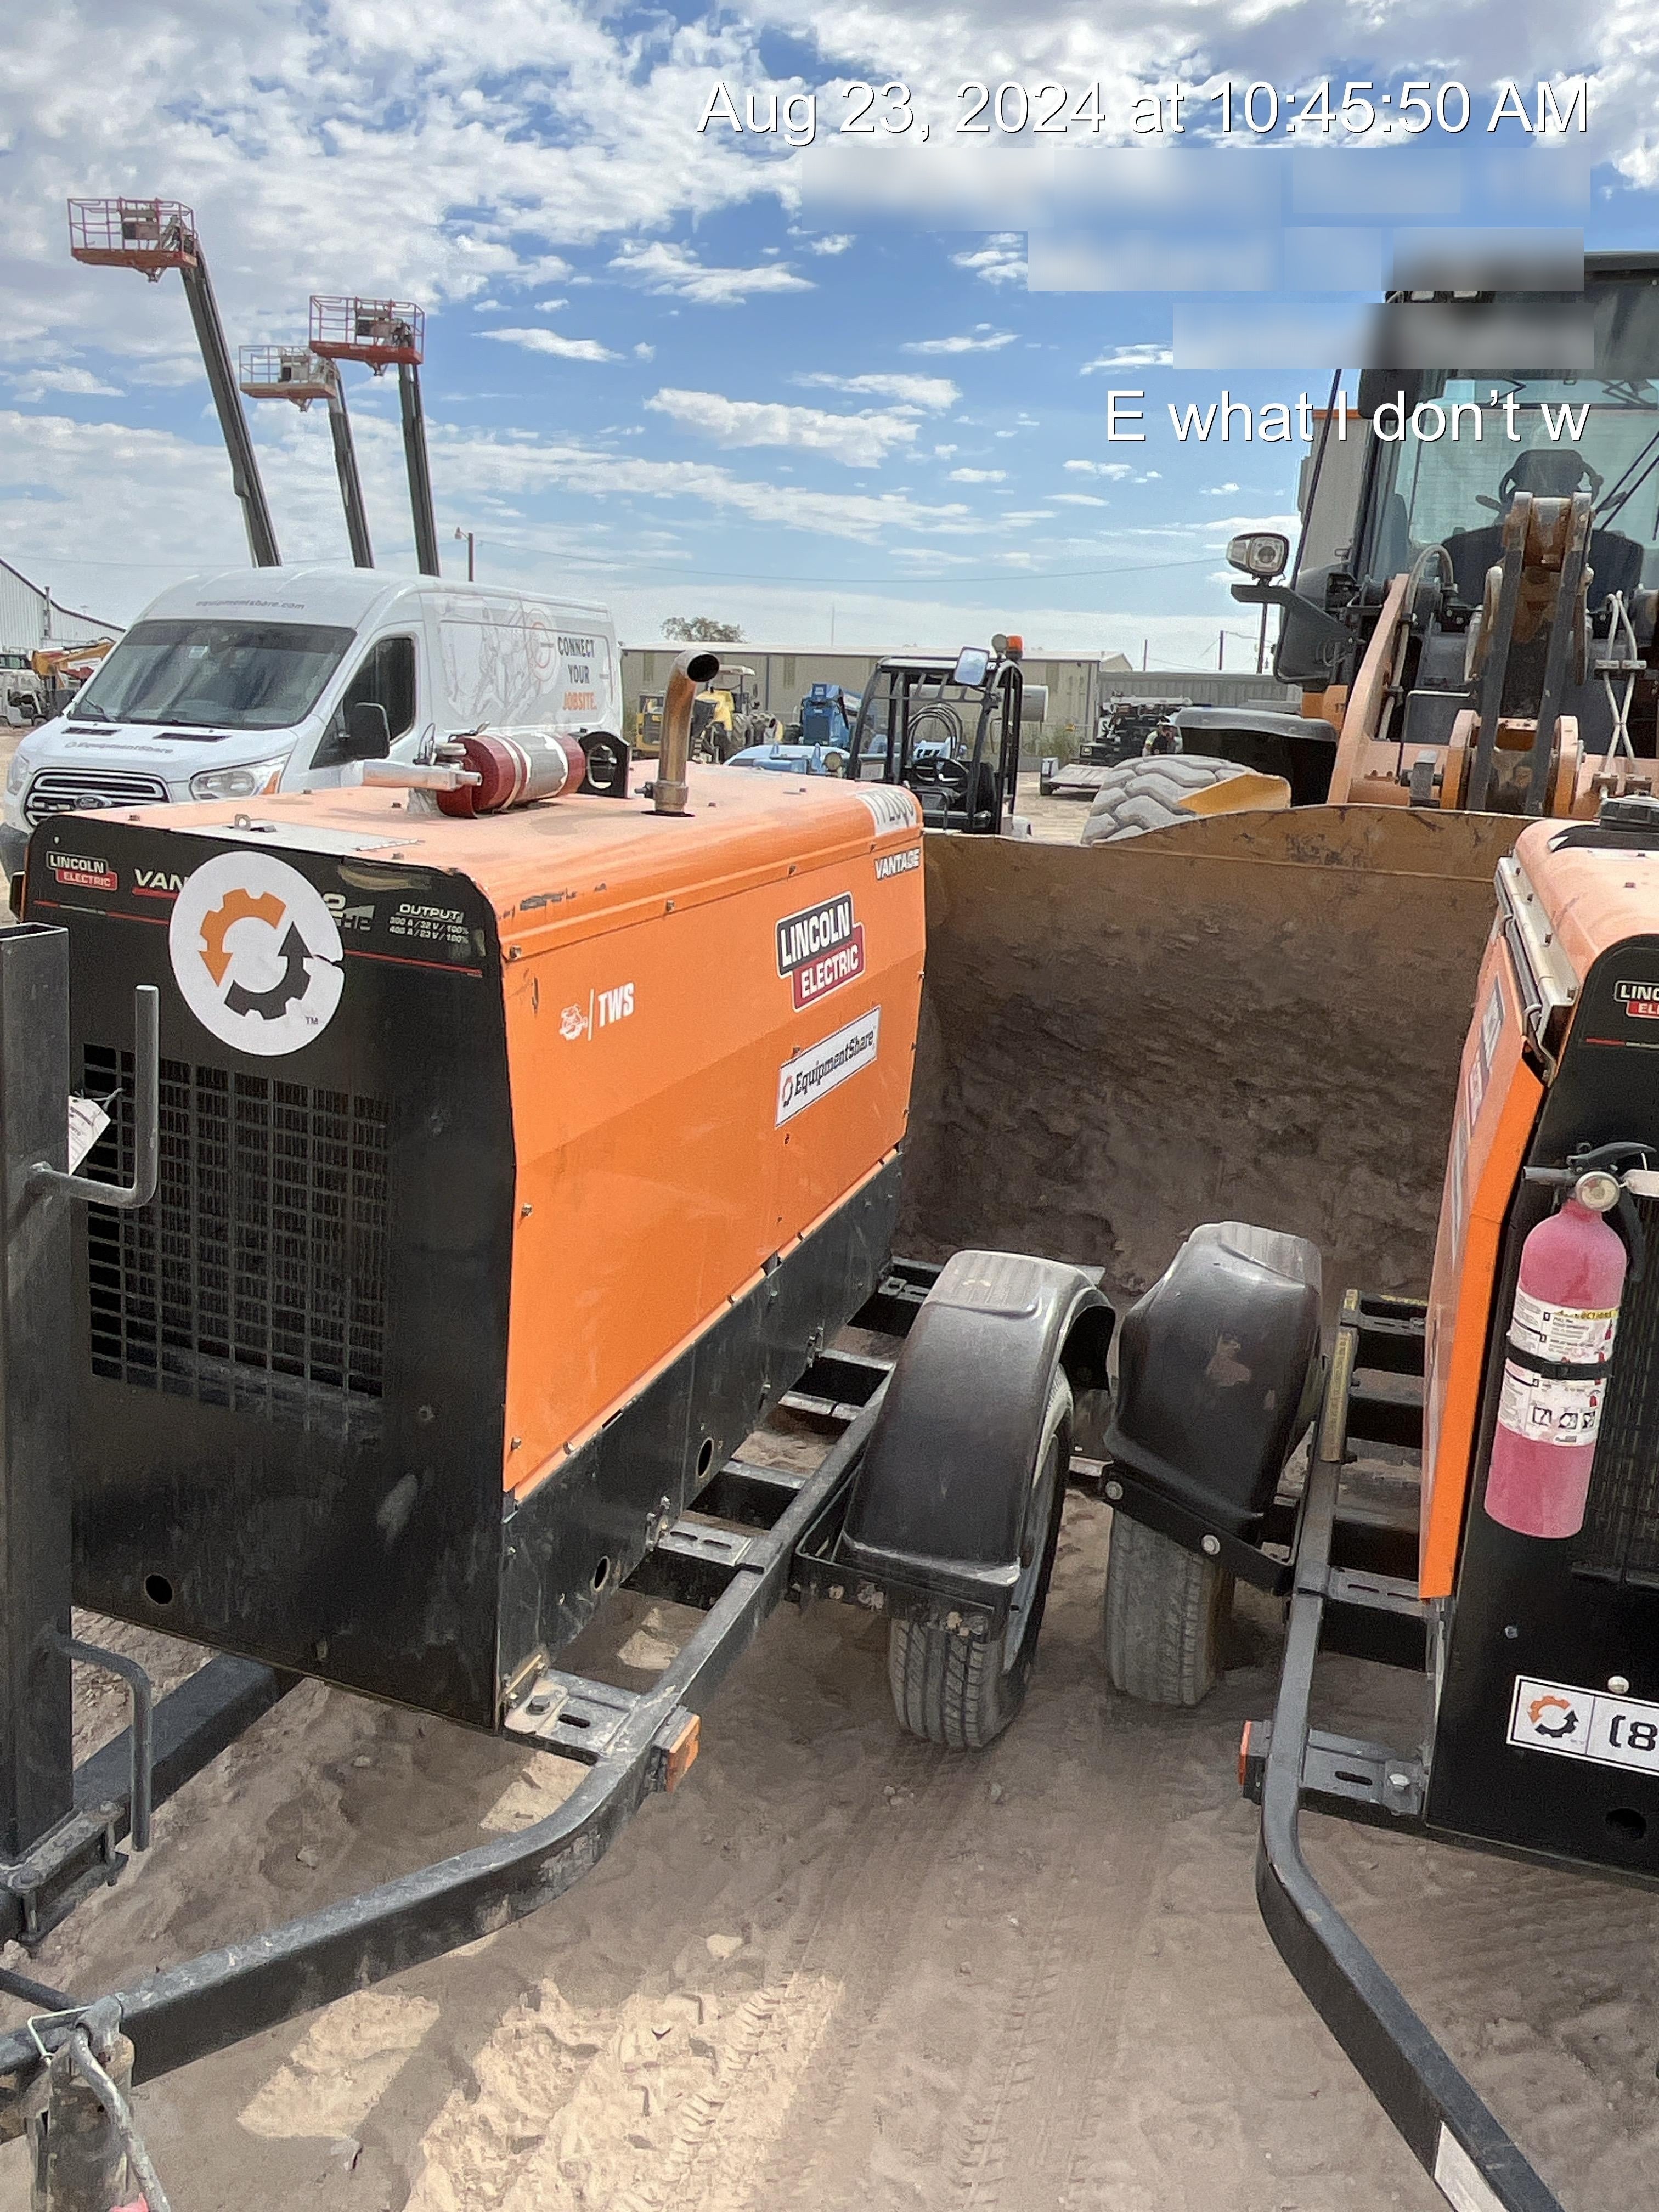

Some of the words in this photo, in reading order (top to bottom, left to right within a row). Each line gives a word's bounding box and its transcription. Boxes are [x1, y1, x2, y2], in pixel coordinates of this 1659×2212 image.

[558, 637, 595, 658] CONNECT
[568, 664, 590, 684] YOUR
[50, 855, 104, 874] LINCOLN
[874, 848, 921, 879] VANTAGE
[63, 871, 111, 887] ELECTRIC
[400, 903, 461, 920] OUTPUT
[780, 901, 850, 967] LINCOLN
[801, 944, 859, 998] ELECTRIC
[597, 982, 635, 1028] TWS
[1638, 1003, 1659, 1015] EL
[794, 1031, 874, 1097] EquipmentShare
